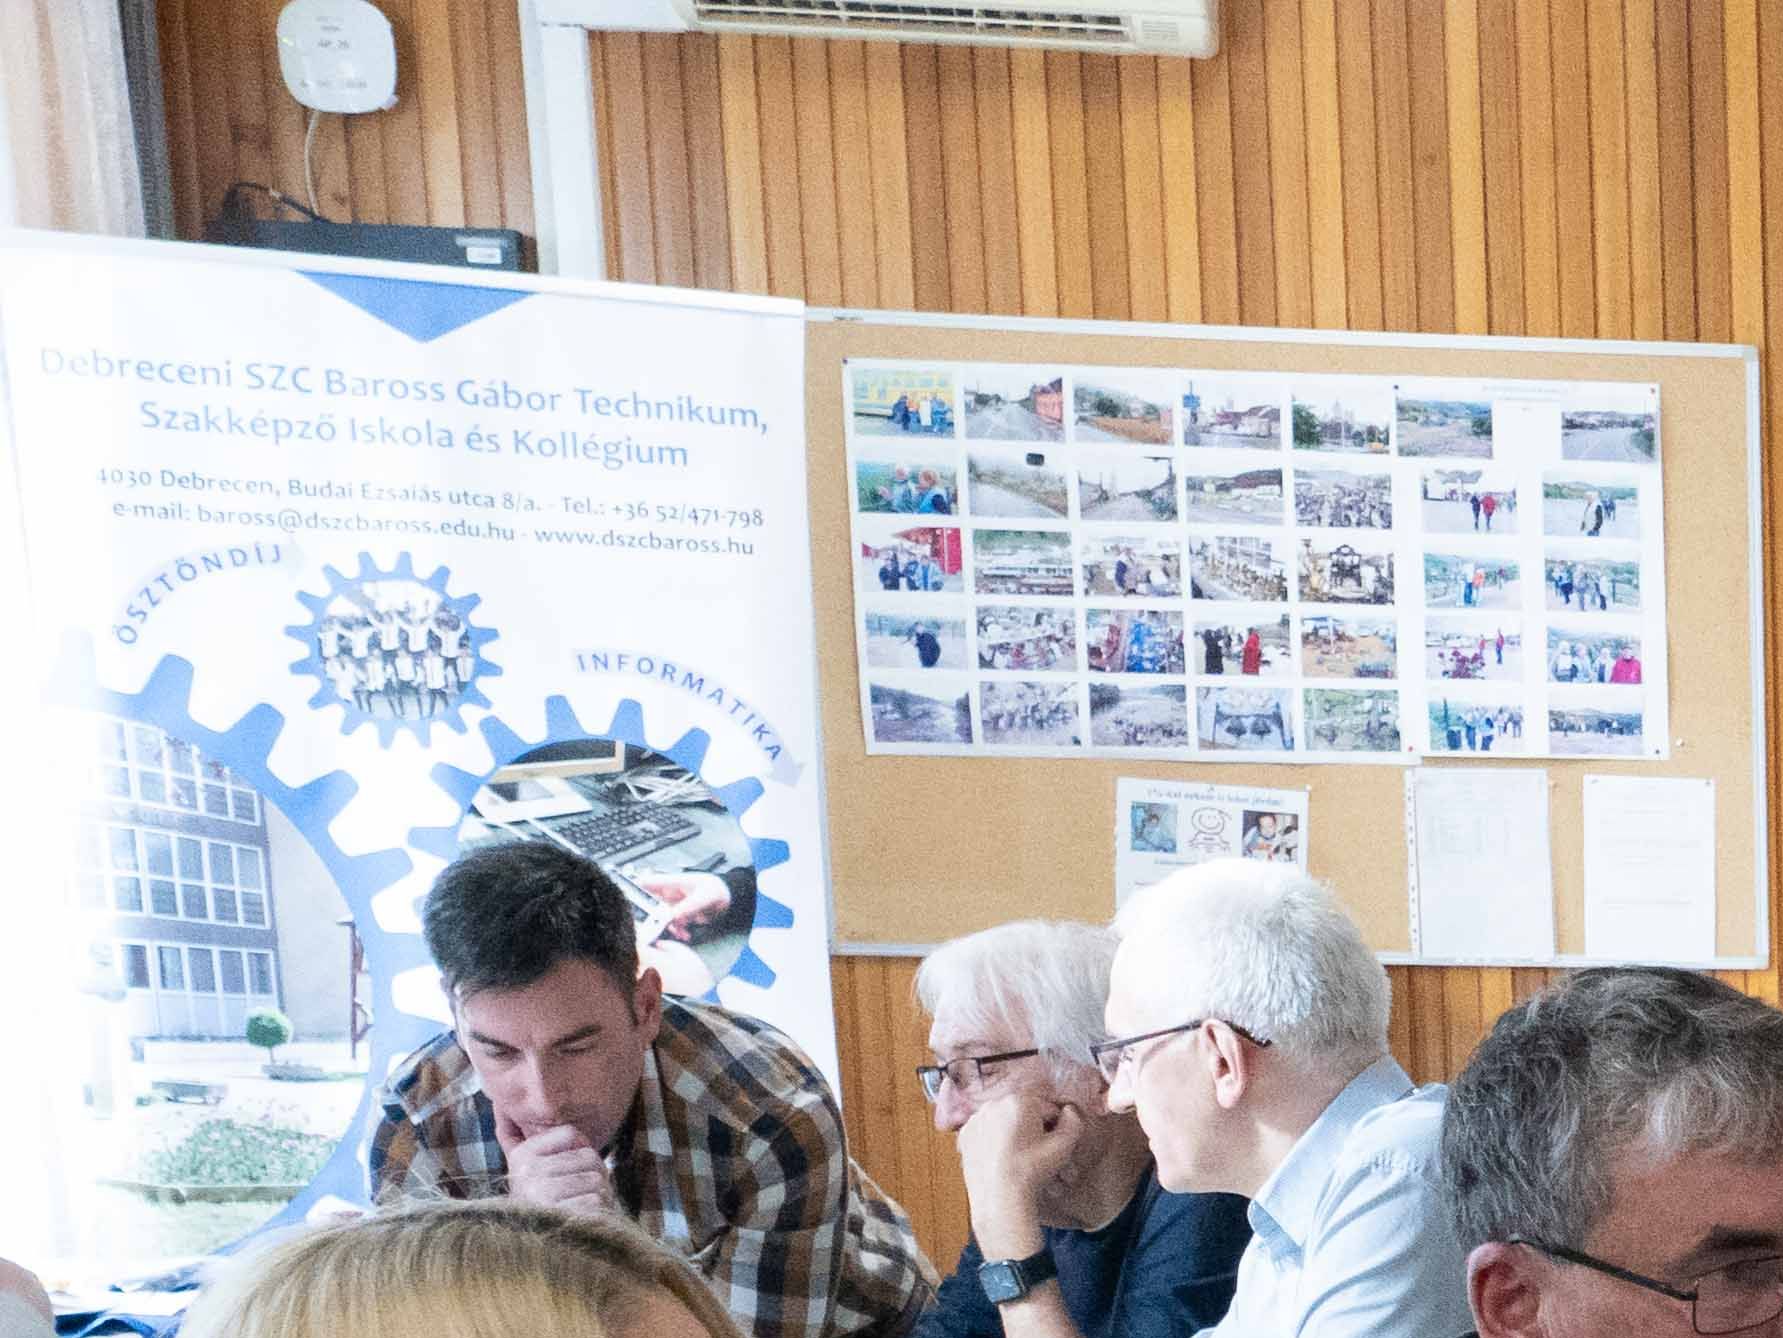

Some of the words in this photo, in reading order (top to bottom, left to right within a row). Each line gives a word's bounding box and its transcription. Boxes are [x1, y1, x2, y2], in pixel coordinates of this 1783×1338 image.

[40, 347, 233, 388] Debreceni
[246, 362, 313, 394] SZC
[325, 368, 446, 402] Baross
[457, 379, 563, 413] Gábor
[573, 387, 768, 436] Technikum,
[140, 400, 337, 446] Szakképző
[351, 416, 454, 450] Iskola
[466, 424, 501, 454] és
[513, 428, 689, 470] Kollégium
[112, 500, 191, 521] e-mail:
[534, 528, 755, 556] www.dszcbaross.hu
[160, 469, 281, 498] Debrecen,
[288, 478, 353, 500] Budai
[449, 489, 496, 509] utca
[502, 491, 542, 514] 8/a.
[613, 501, 649, 520] +36
[576, 653, 782, 760] INFORMATIKA
